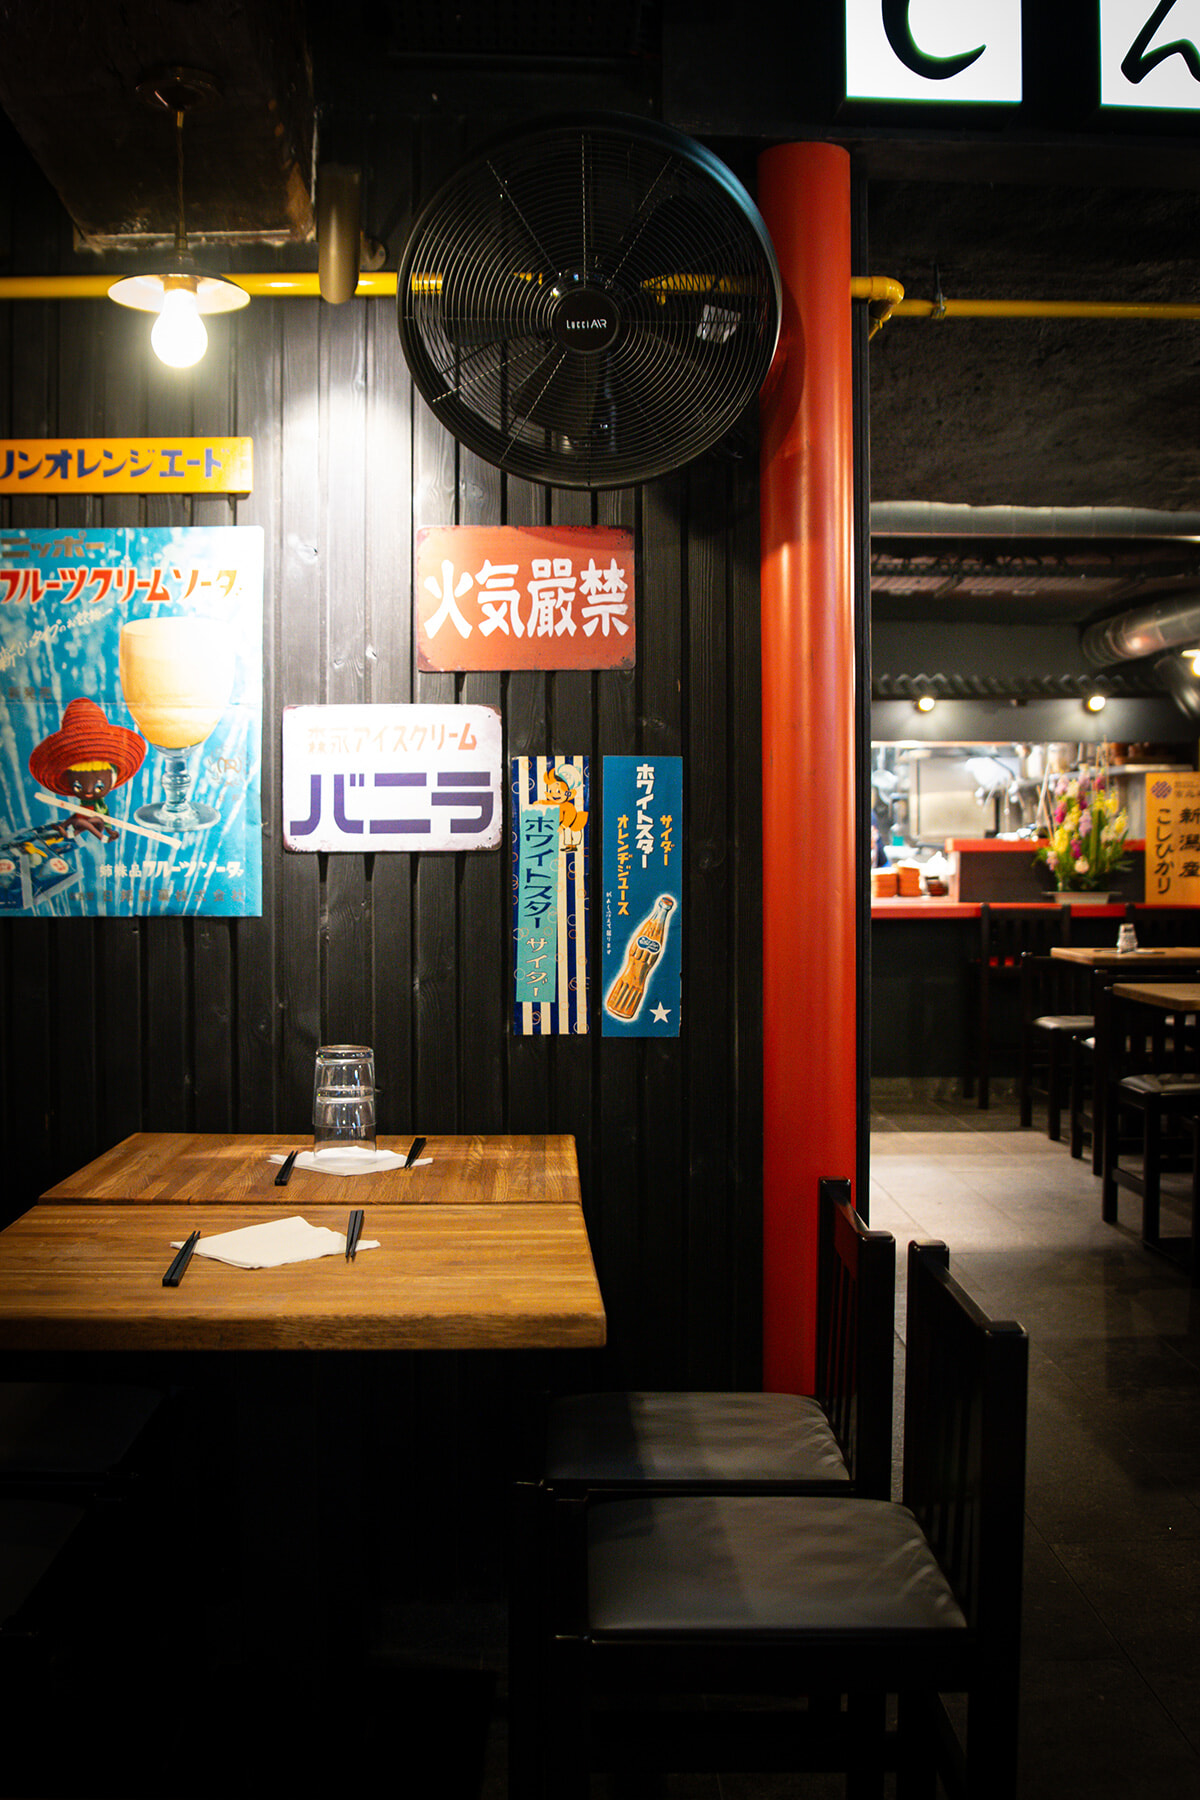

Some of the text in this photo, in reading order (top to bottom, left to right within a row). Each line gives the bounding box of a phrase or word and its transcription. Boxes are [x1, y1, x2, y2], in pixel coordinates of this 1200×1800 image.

[289, 770, 494, 837] バニラ
[635, 763, 655, 869] ホワイトスター
[659, 814, 675, 866] サイダー
[1154, 808, 1175, 895] こしひかり
[523, 816, 555, 997] ホワイトスター サイダー
